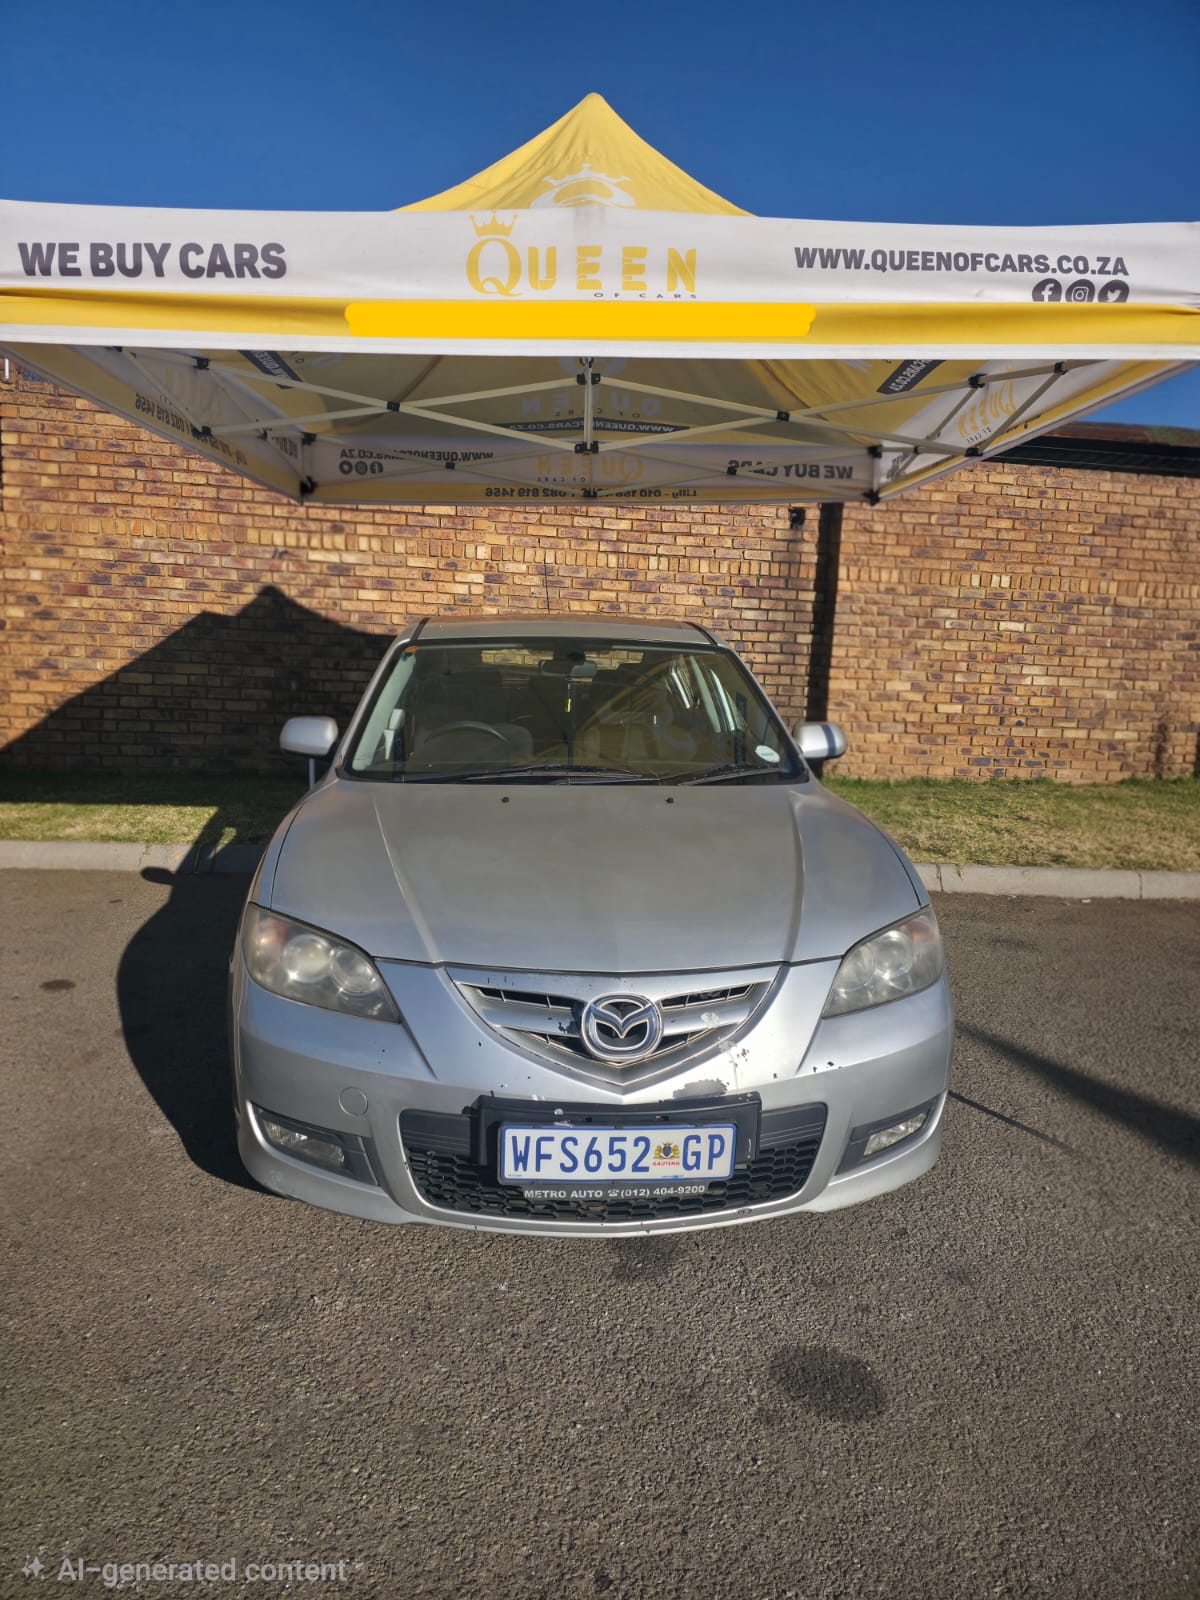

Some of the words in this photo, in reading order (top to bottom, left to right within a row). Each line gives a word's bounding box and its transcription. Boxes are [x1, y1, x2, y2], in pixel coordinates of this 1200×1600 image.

[18, 242, 81, 277] WE
[90, 242, 171, 278] BUY
[179, 242, 287, 279] CARS
[466, 237, 697, 297] QUEEN
[794, 247, 1129, 276] WWW.QUEENOFCARS.CO.ZA
[511, 1135, 651, 1173] WFS652
[682, 1134, 726, 1171] GP
[524, 1190, 567, 1199] METRO
[570, 1190, 603, 1198] AUTO
[653, 1185, 706, 1197] 404-9200
